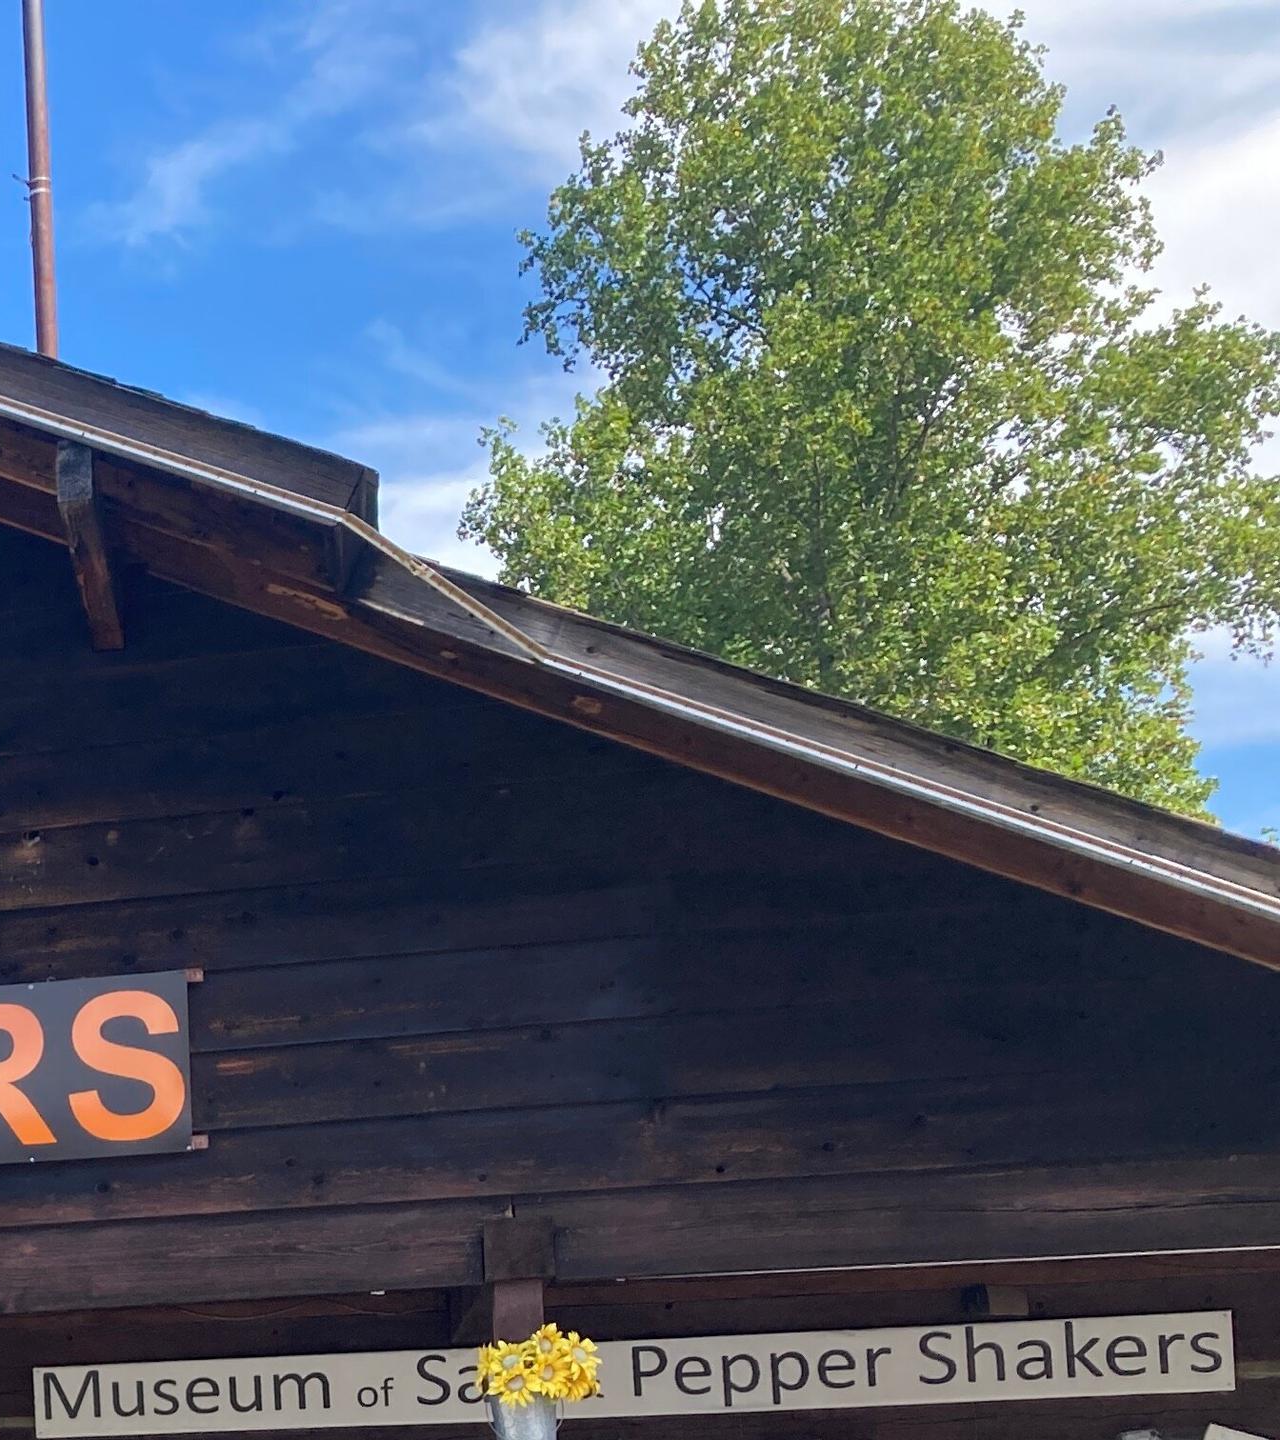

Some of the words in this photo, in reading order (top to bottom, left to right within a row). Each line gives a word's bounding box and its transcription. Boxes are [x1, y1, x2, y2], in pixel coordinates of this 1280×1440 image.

[42, 1370, 331, 1420] Museum
[357, 1377, 394, 1407] of
[631, 1344, 892, 1407] Pepper
[918, 1321, 1224, 1385] Shakers
